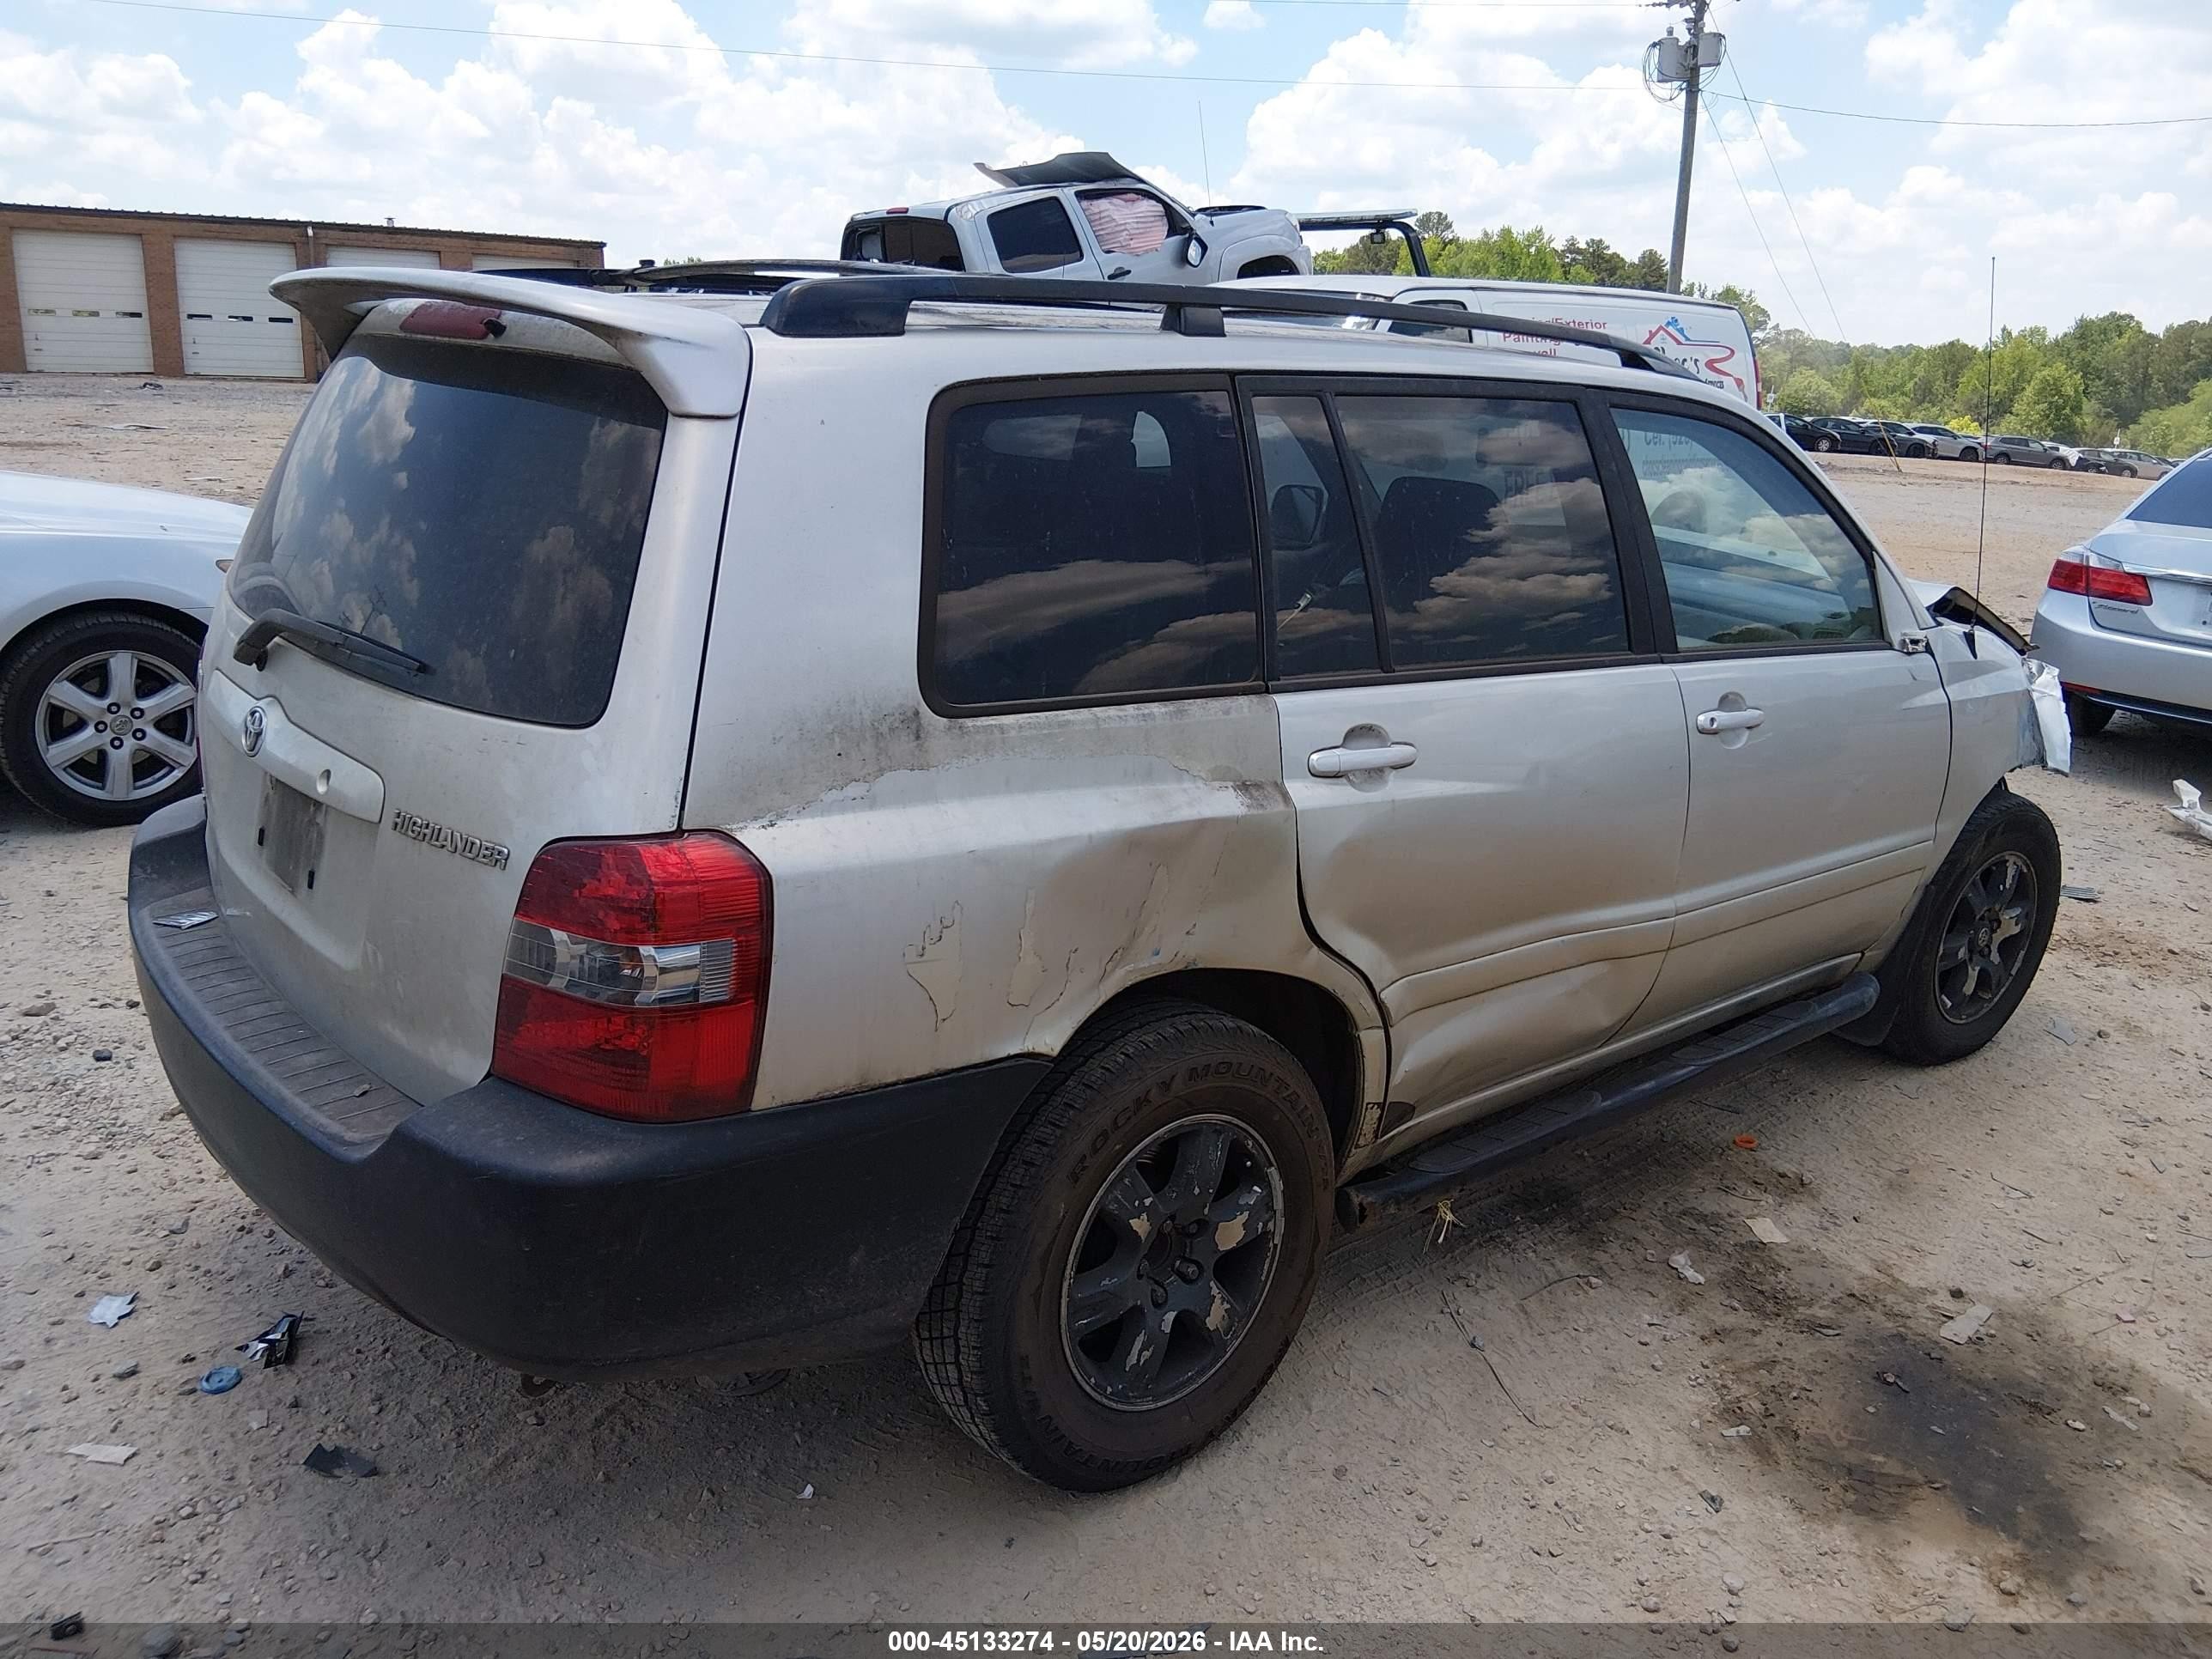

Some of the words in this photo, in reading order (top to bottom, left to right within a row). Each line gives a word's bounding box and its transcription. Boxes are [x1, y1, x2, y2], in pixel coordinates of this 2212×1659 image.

[391, 808, 510, 871] HIGHLANDER
[1067, 1073, 1178, 1186] ROCKY
[1186, 1060, 1321, 1140] MOUNTAIN
